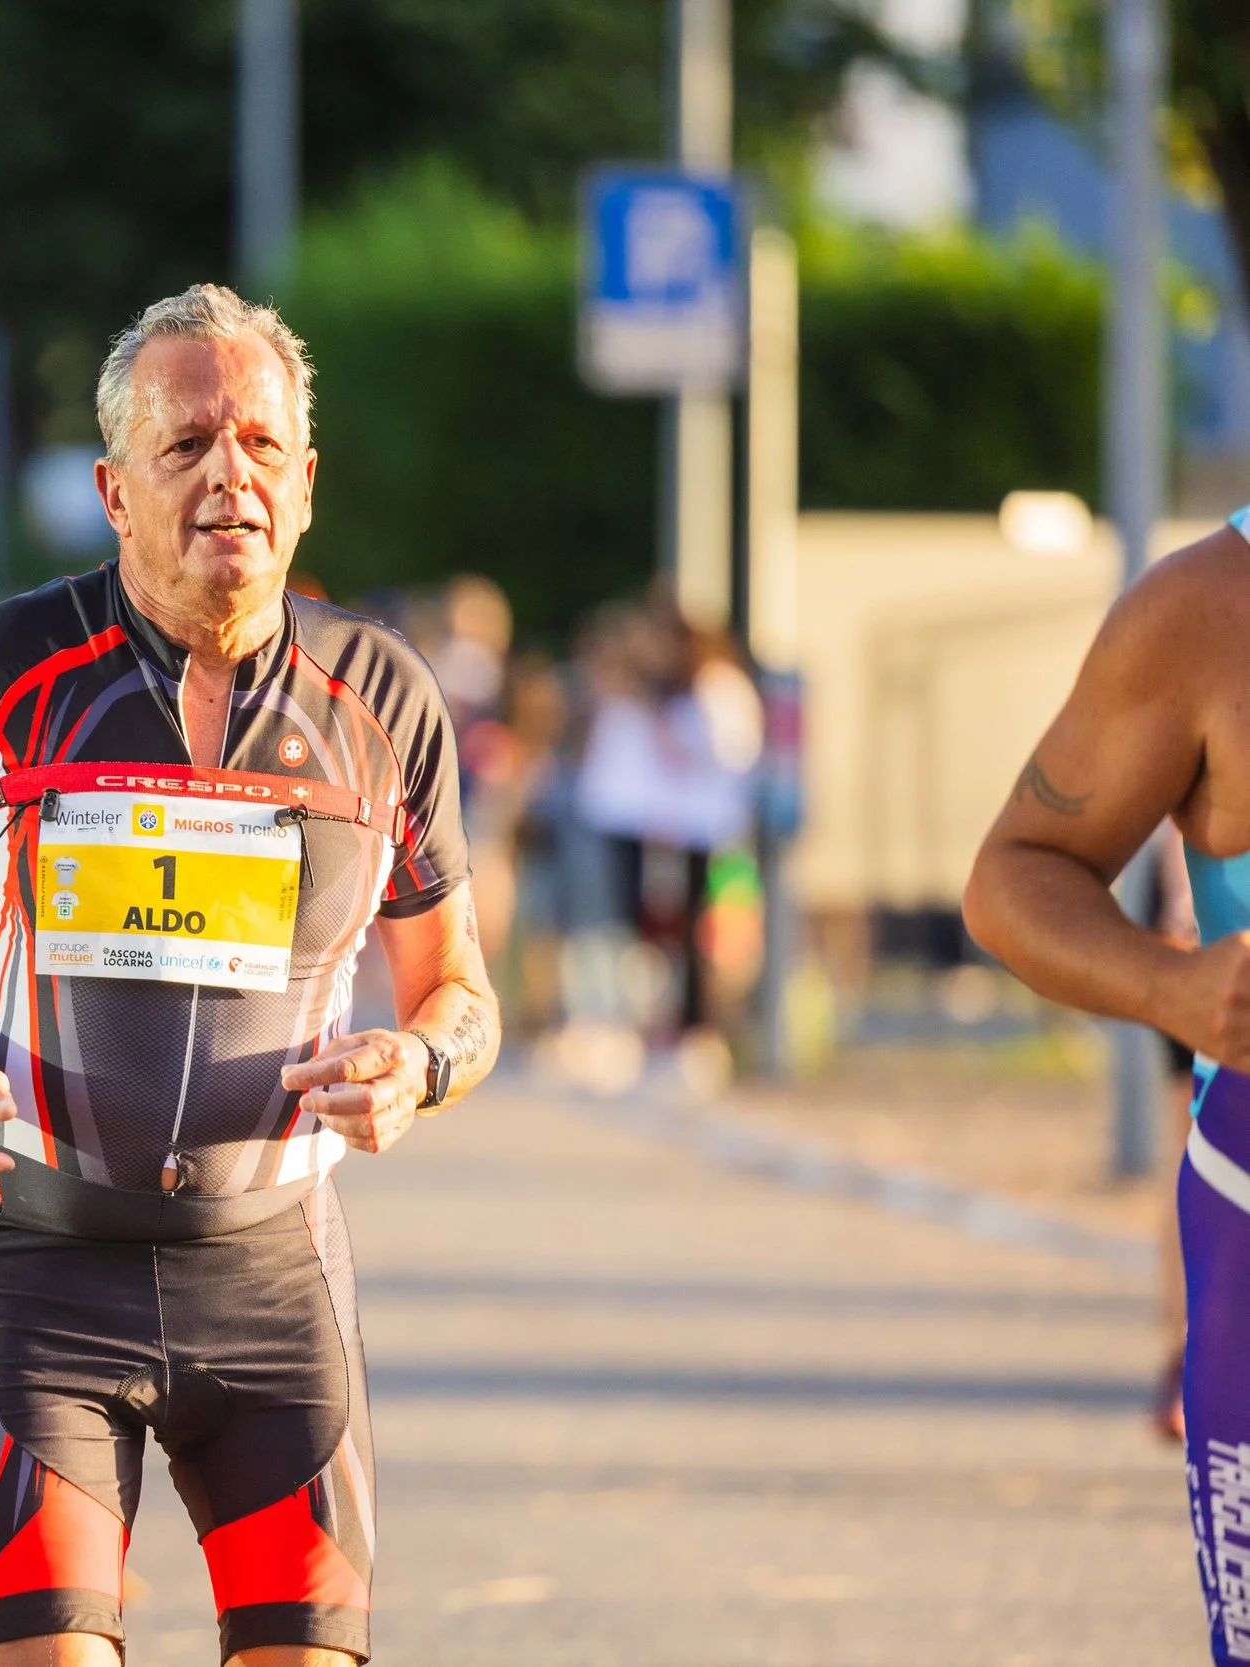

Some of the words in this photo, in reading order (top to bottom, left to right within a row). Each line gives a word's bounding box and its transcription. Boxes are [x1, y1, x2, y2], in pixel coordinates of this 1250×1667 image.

[56, 810, 122, 826] Winteler
[174, 818, 234, 834] MIGROS
[239, 824, 287, 839] TICINO
[153, 855, 176, 900] 1
[122, 906, 206, 934] ALDO
[49, 942, 89, 953] groupe
[110, 949, 153, 959] ASCONA
[49, 952, 93, 963] mutuel
[103, 958, 153, 968] LOCARNO
[159, 953, 205, 969] unicef
